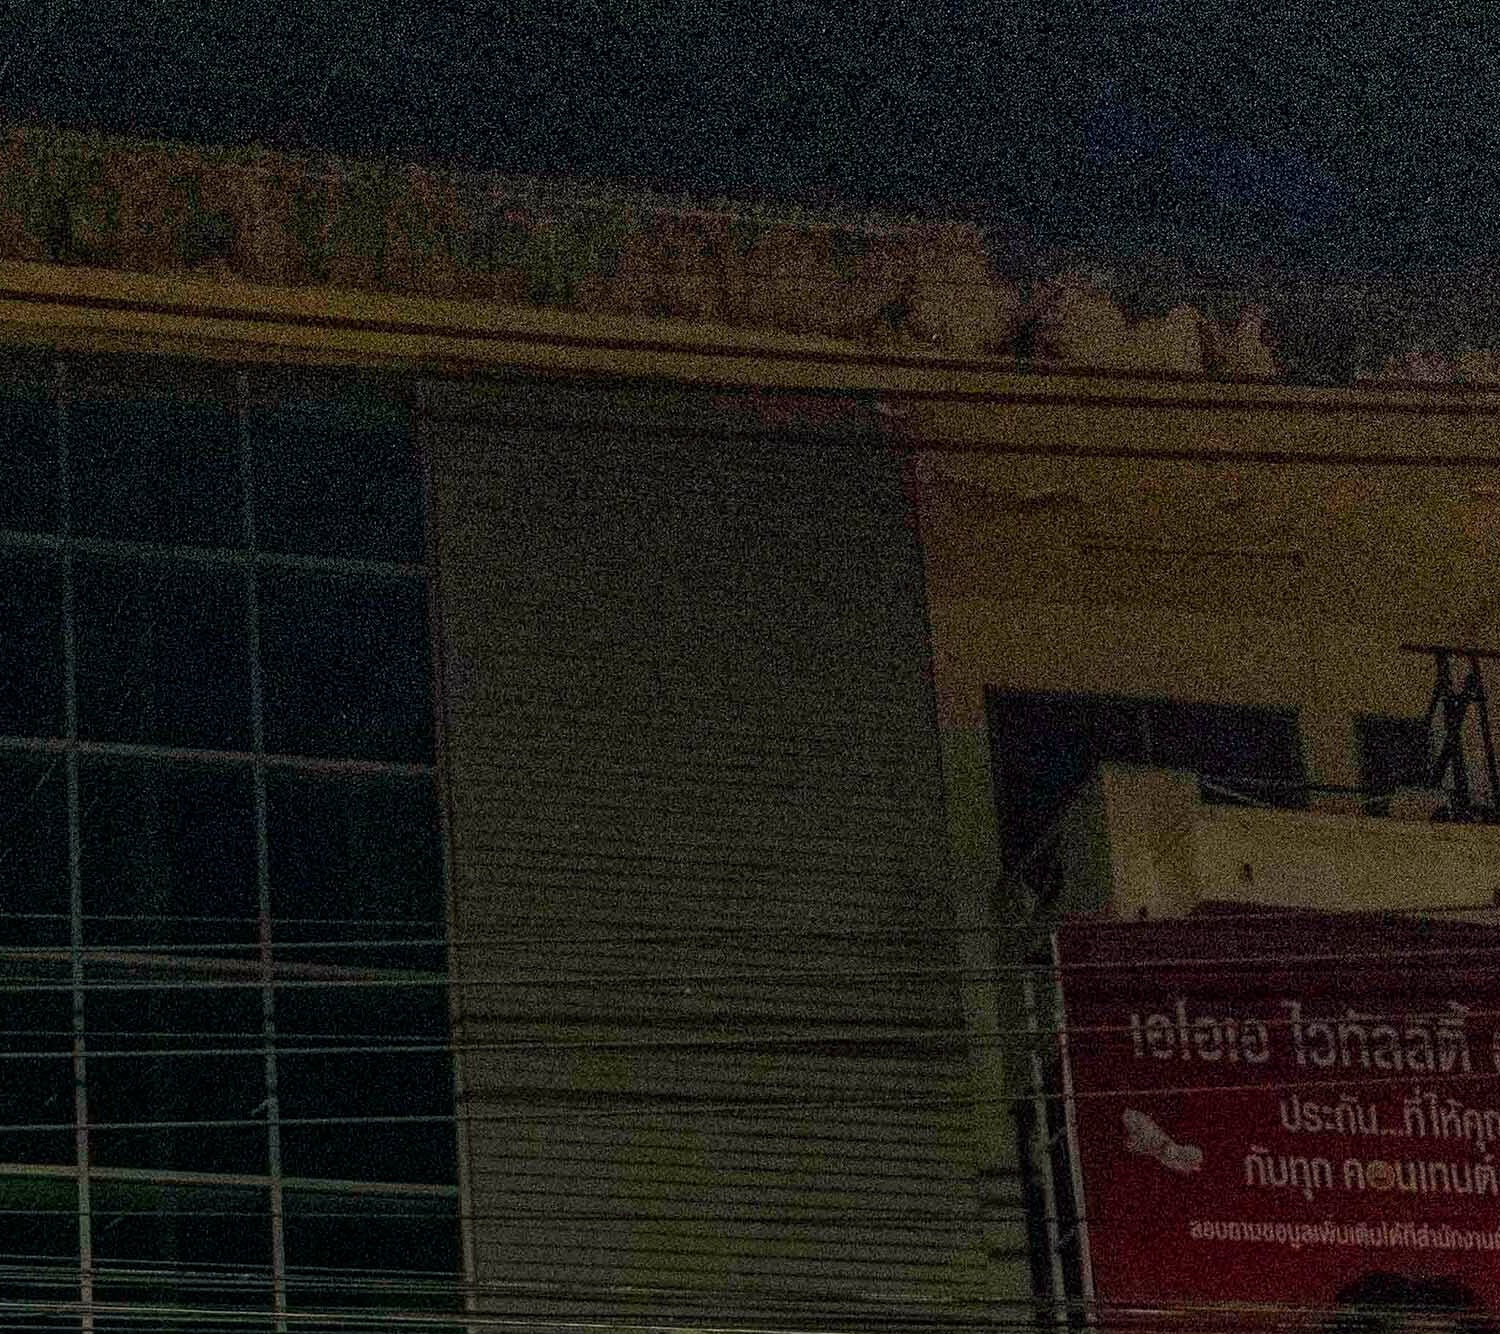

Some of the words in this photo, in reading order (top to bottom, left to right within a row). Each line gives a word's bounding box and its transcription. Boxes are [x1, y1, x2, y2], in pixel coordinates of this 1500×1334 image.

[1130, 997, 1271, 1064] เอไอเอ
[1245, 1143, 1333, 1200] กับทุก
